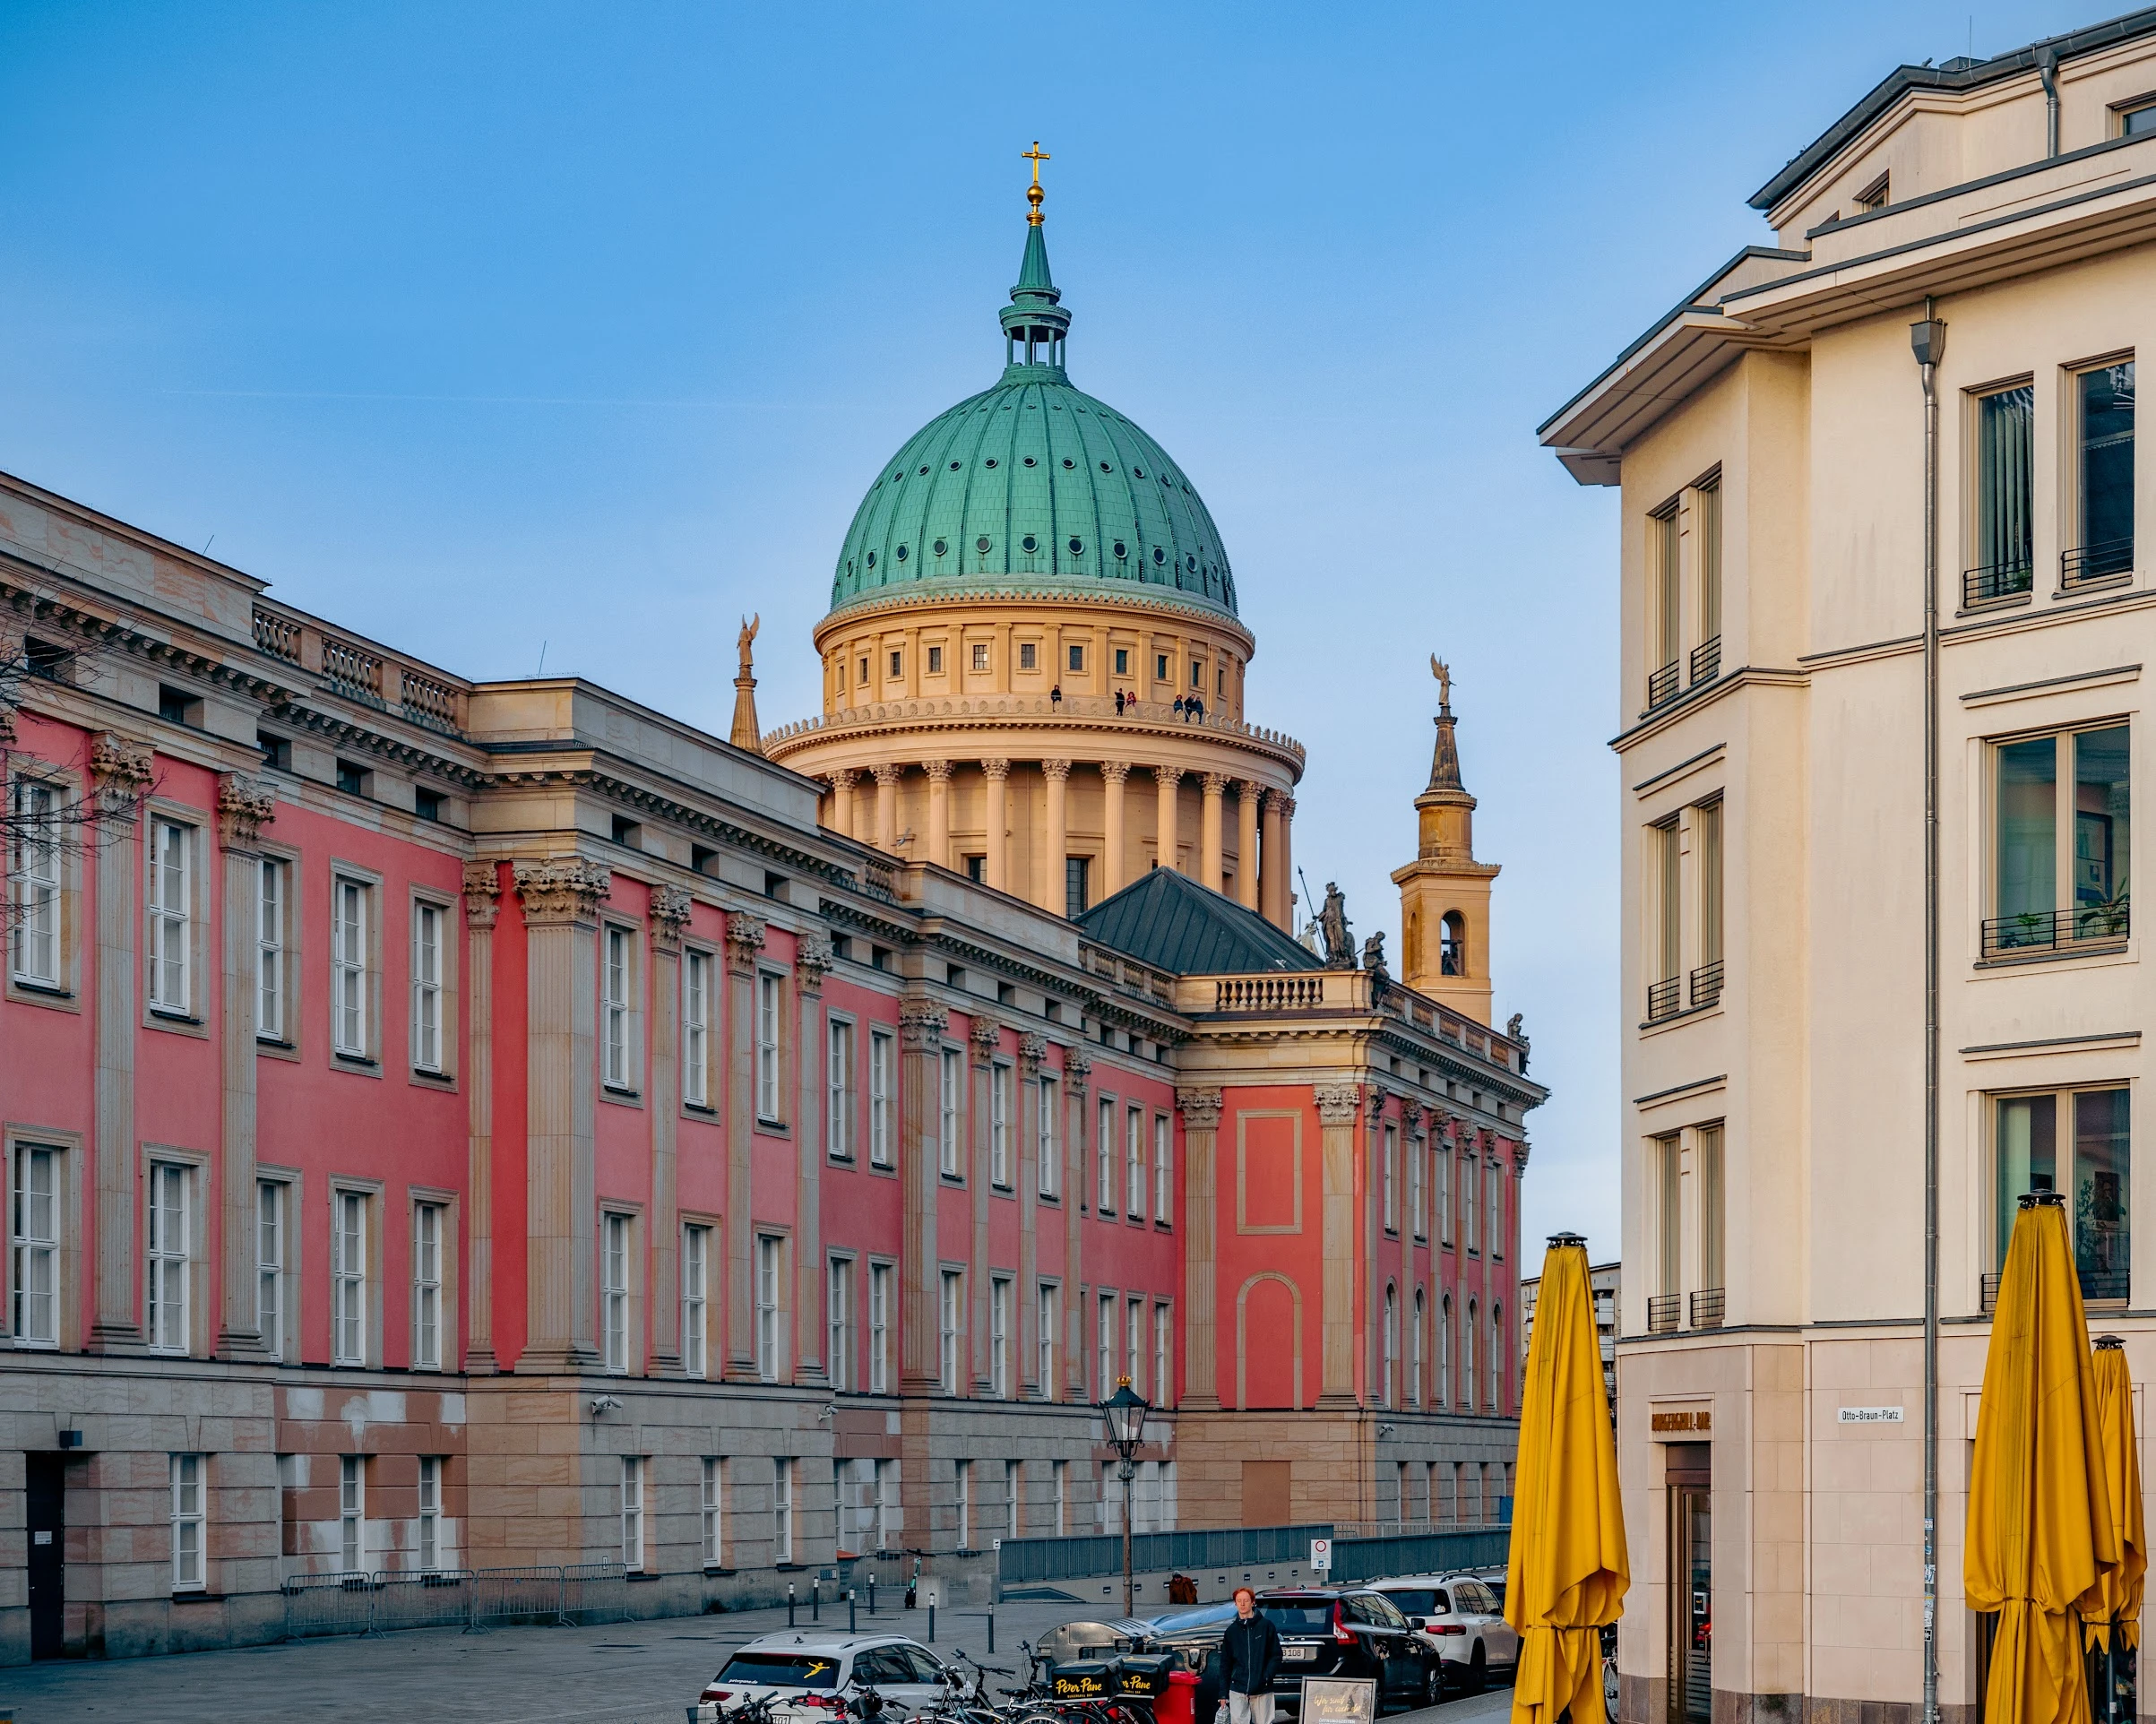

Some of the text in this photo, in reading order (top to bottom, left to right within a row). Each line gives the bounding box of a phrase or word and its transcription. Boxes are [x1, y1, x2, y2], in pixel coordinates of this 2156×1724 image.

[1841, 1410, 1899, 1420] Otto-Braun-Platz
[1056, 1677, 1102, 1694] Peter Pane
[1130, 1676, 1151, 1689] Pane
